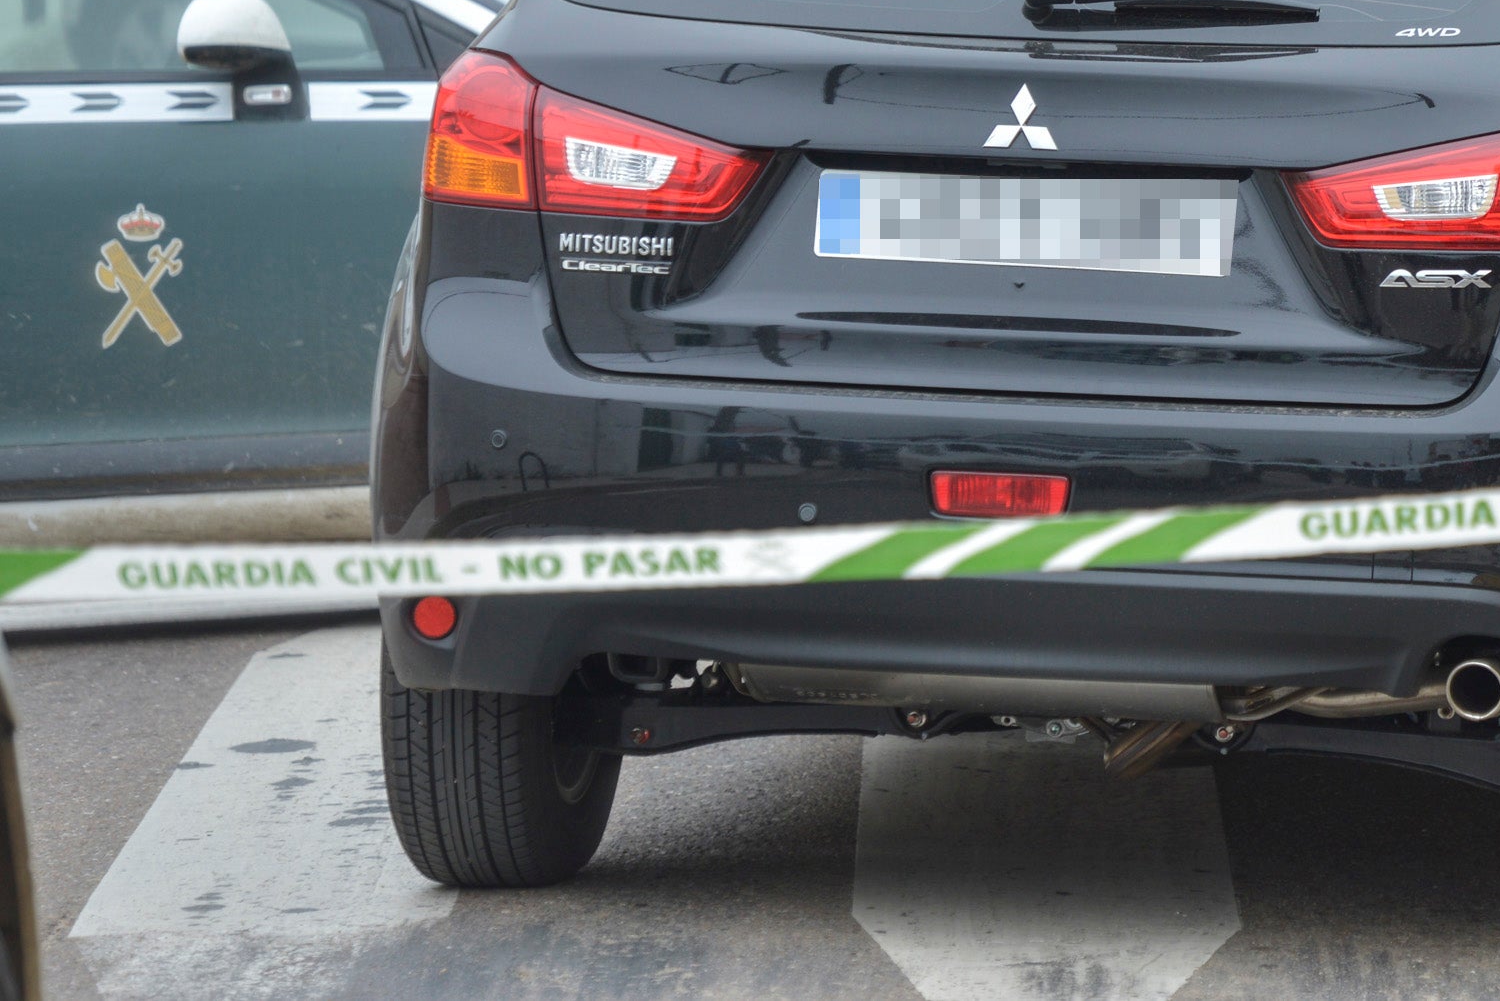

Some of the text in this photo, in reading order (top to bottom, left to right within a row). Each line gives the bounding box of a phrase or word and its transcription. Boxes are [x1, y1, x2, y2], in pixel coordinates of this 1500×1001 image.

[1395, 27, 1461, 37] 4WD
[560, 233, 674, 256] MITSUBISHI
[562, 260, 671, 275] ClearTec
[1379, 268, 1493, 288] ASX
[1299, 499, 1497, 540] GUARDIA
[117, 558, 316, 589] GUARDIA
[334, 554, 443, 585] CIVIL
[499, 550, 562, 581] NO
[581, 546, 720, 578] PASAR
